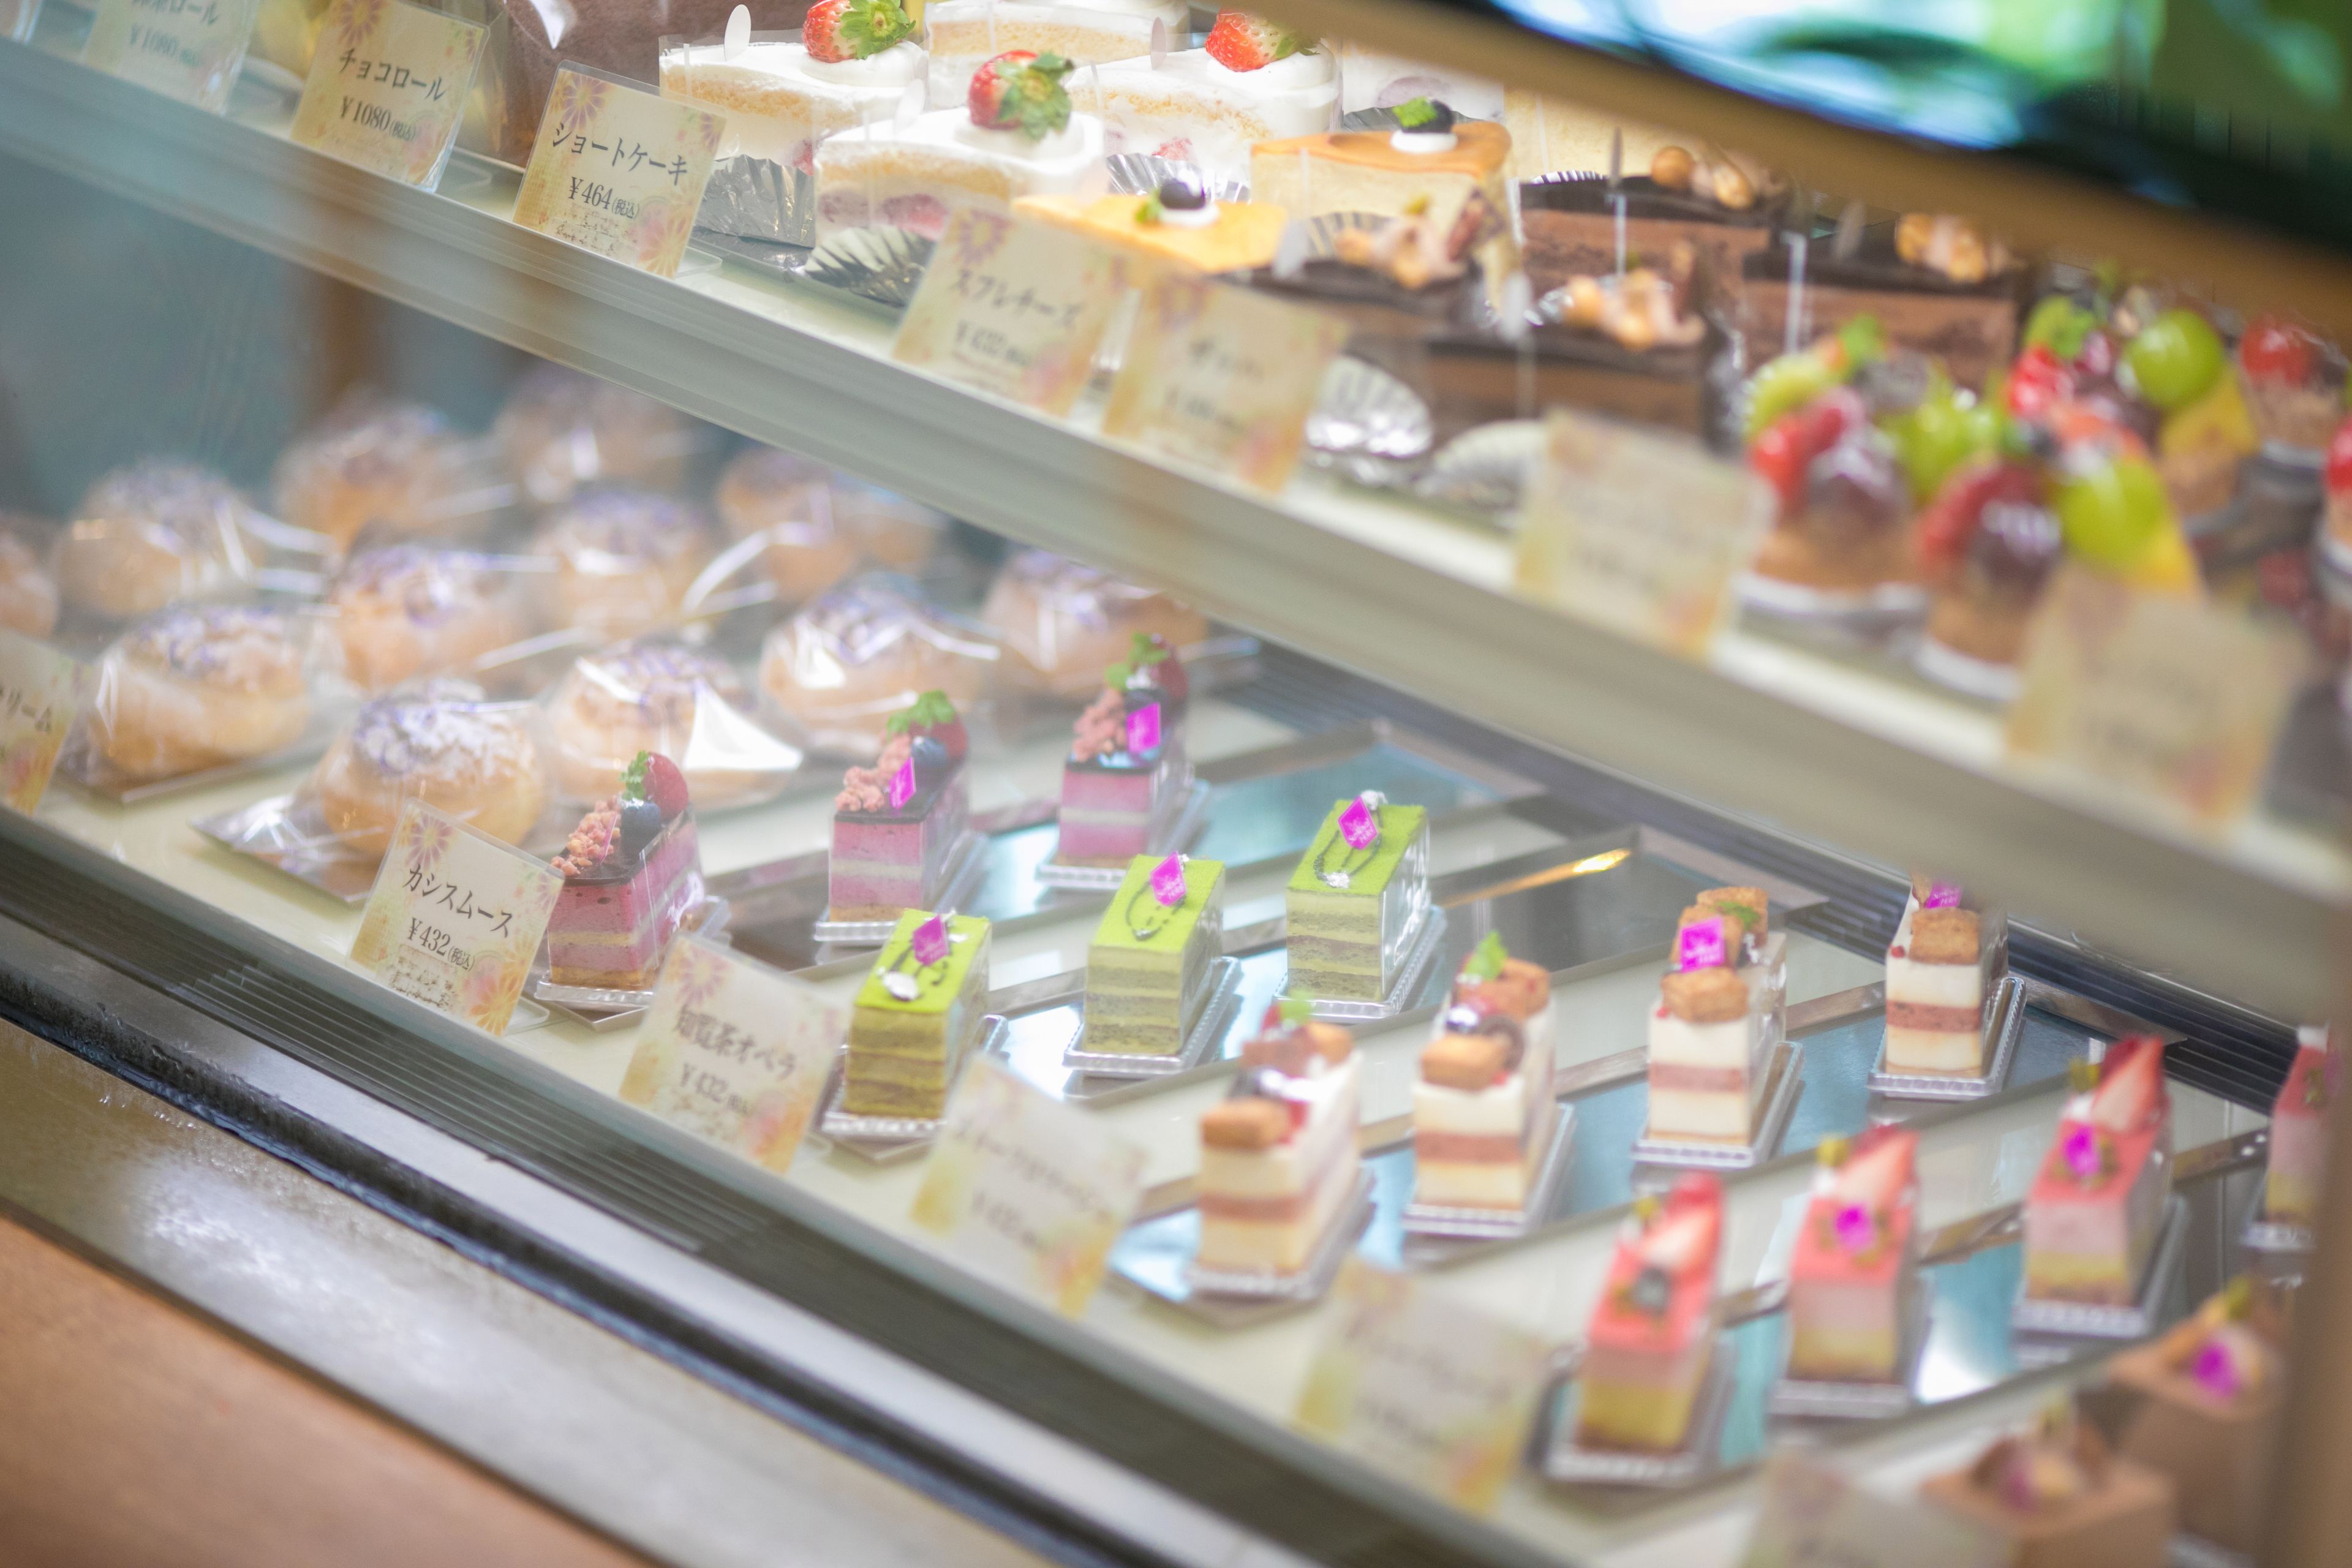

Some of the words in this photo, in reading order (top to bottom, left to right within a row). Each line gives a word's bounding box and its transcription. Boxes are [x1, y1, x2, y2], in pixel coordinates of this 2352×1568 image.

[339, 47, 447, 102] チョコロール
[552, 122, 688, 186] ショートケーキ
[568, 176, 640, 219] ¥464(税込)
[0, 684, 51, 734] リーム
[402, 863, 513, 938] カシスムース
[407, 918, 475, 971] ¥432(税込)
